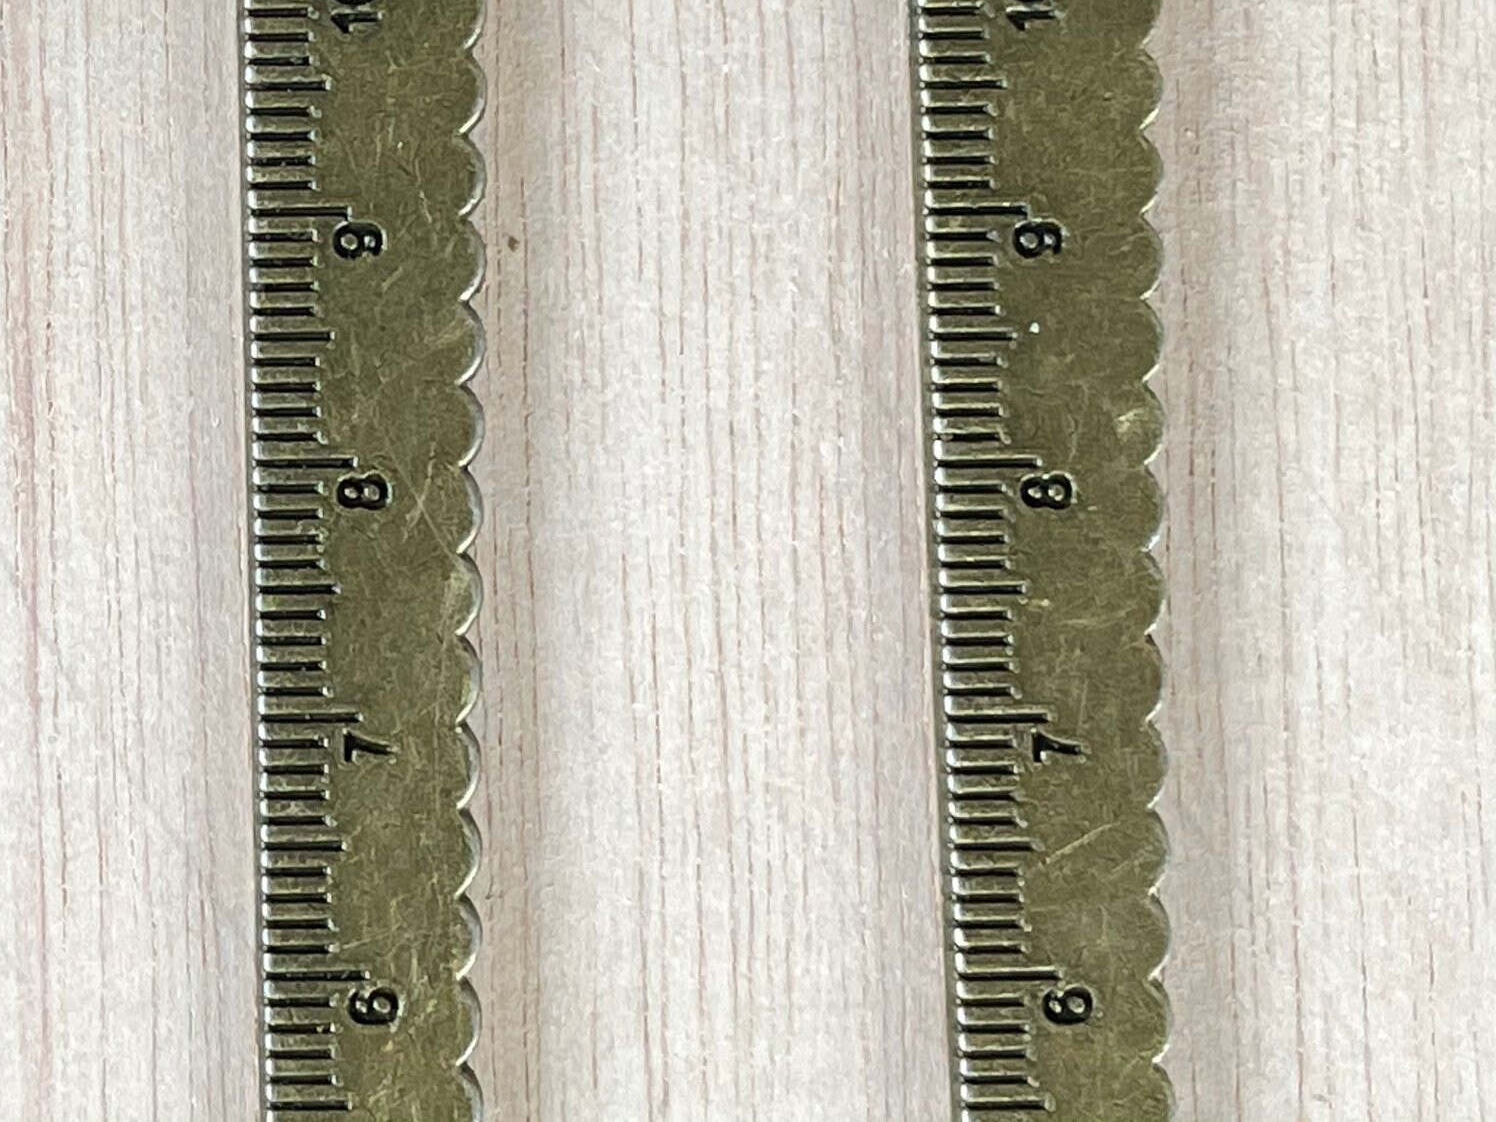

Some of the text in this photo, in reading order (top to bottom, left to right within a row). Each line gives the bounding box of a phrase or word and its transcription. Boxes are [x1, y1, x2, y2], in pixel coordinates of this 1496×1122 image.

[333, 222, 385, 259] 9
[1012, 220, 1064, 258] 9
[335, 472, 390, 510] 8
[1018, 474, 1074, 510] 8
[343, 730, 395, 764] 7
[1031, 730, 1084, 764] 7
[348, 988, 400, 1026] 6
[1041, 986, 1094, 1026] 6
